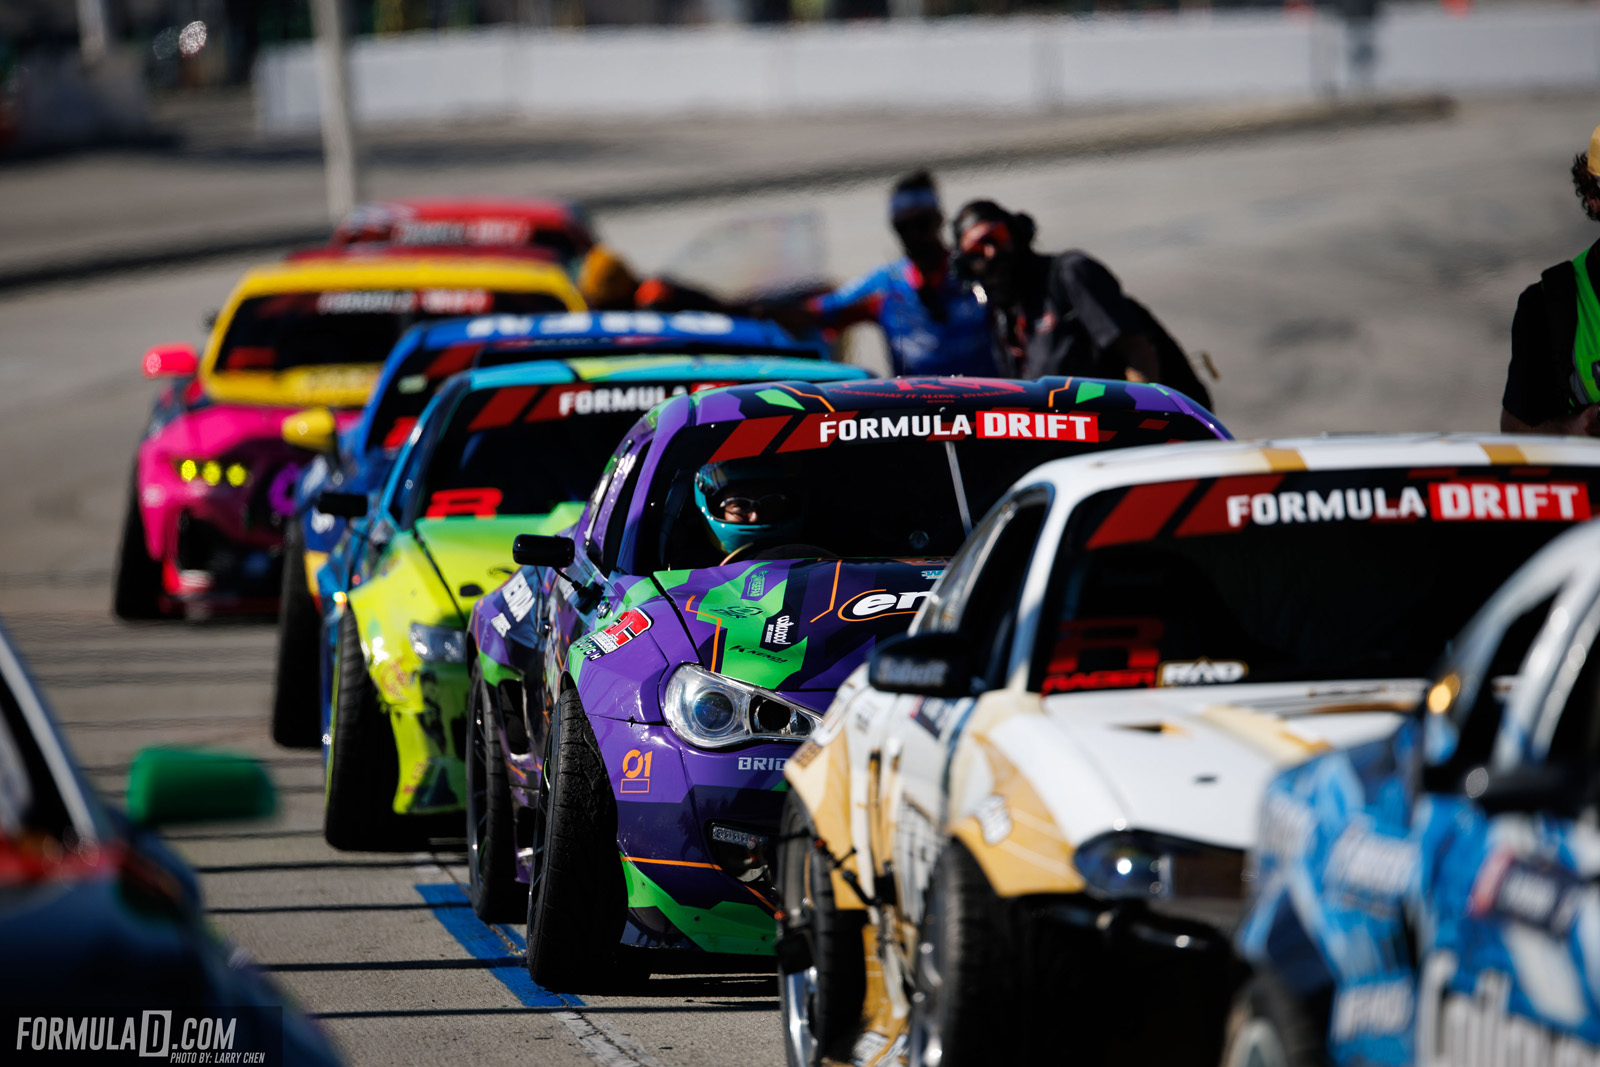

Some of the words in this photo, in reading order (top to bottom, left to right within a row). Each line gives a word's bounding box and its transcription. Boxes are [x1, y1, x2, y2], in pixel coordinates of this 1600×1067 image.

[819, 415, 972, 442] FORMULA
[984, 413, 1091, 439] DRIFT
[1227, 486, 1427, 527] FORMULA
[1437, 484, 1580, 519] DRIFT
